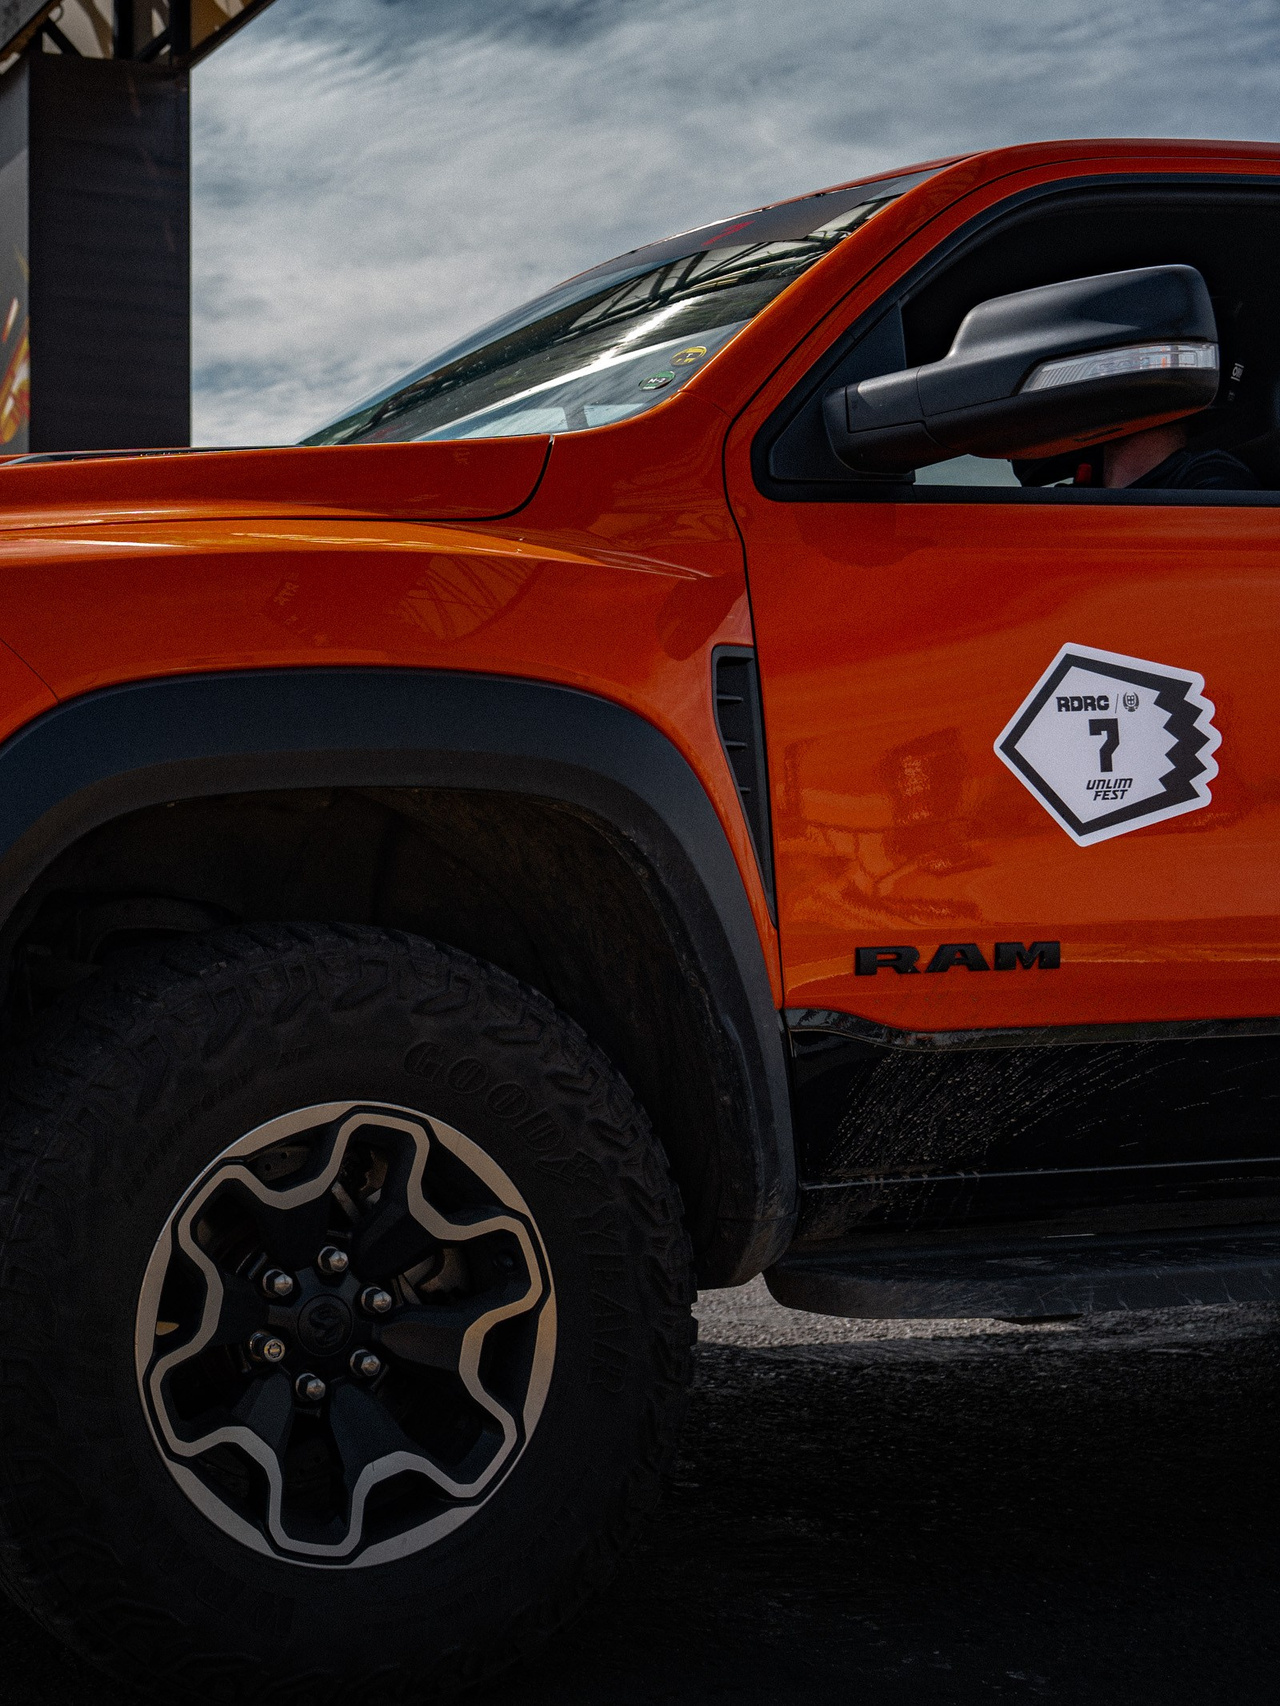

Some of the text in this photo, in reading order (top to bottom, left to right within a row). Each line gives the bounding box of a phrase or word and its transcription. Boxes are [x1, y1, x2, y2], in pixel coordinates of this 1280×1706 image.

[1055, 695, 1110, 712] RDRC
[1088, 718, 1120, 773] 7
[1086, 778, 1133, 791] UNLIM
[1093, 789, 1128, 801] FEST
[854, 940, 1061, 976] RAM
